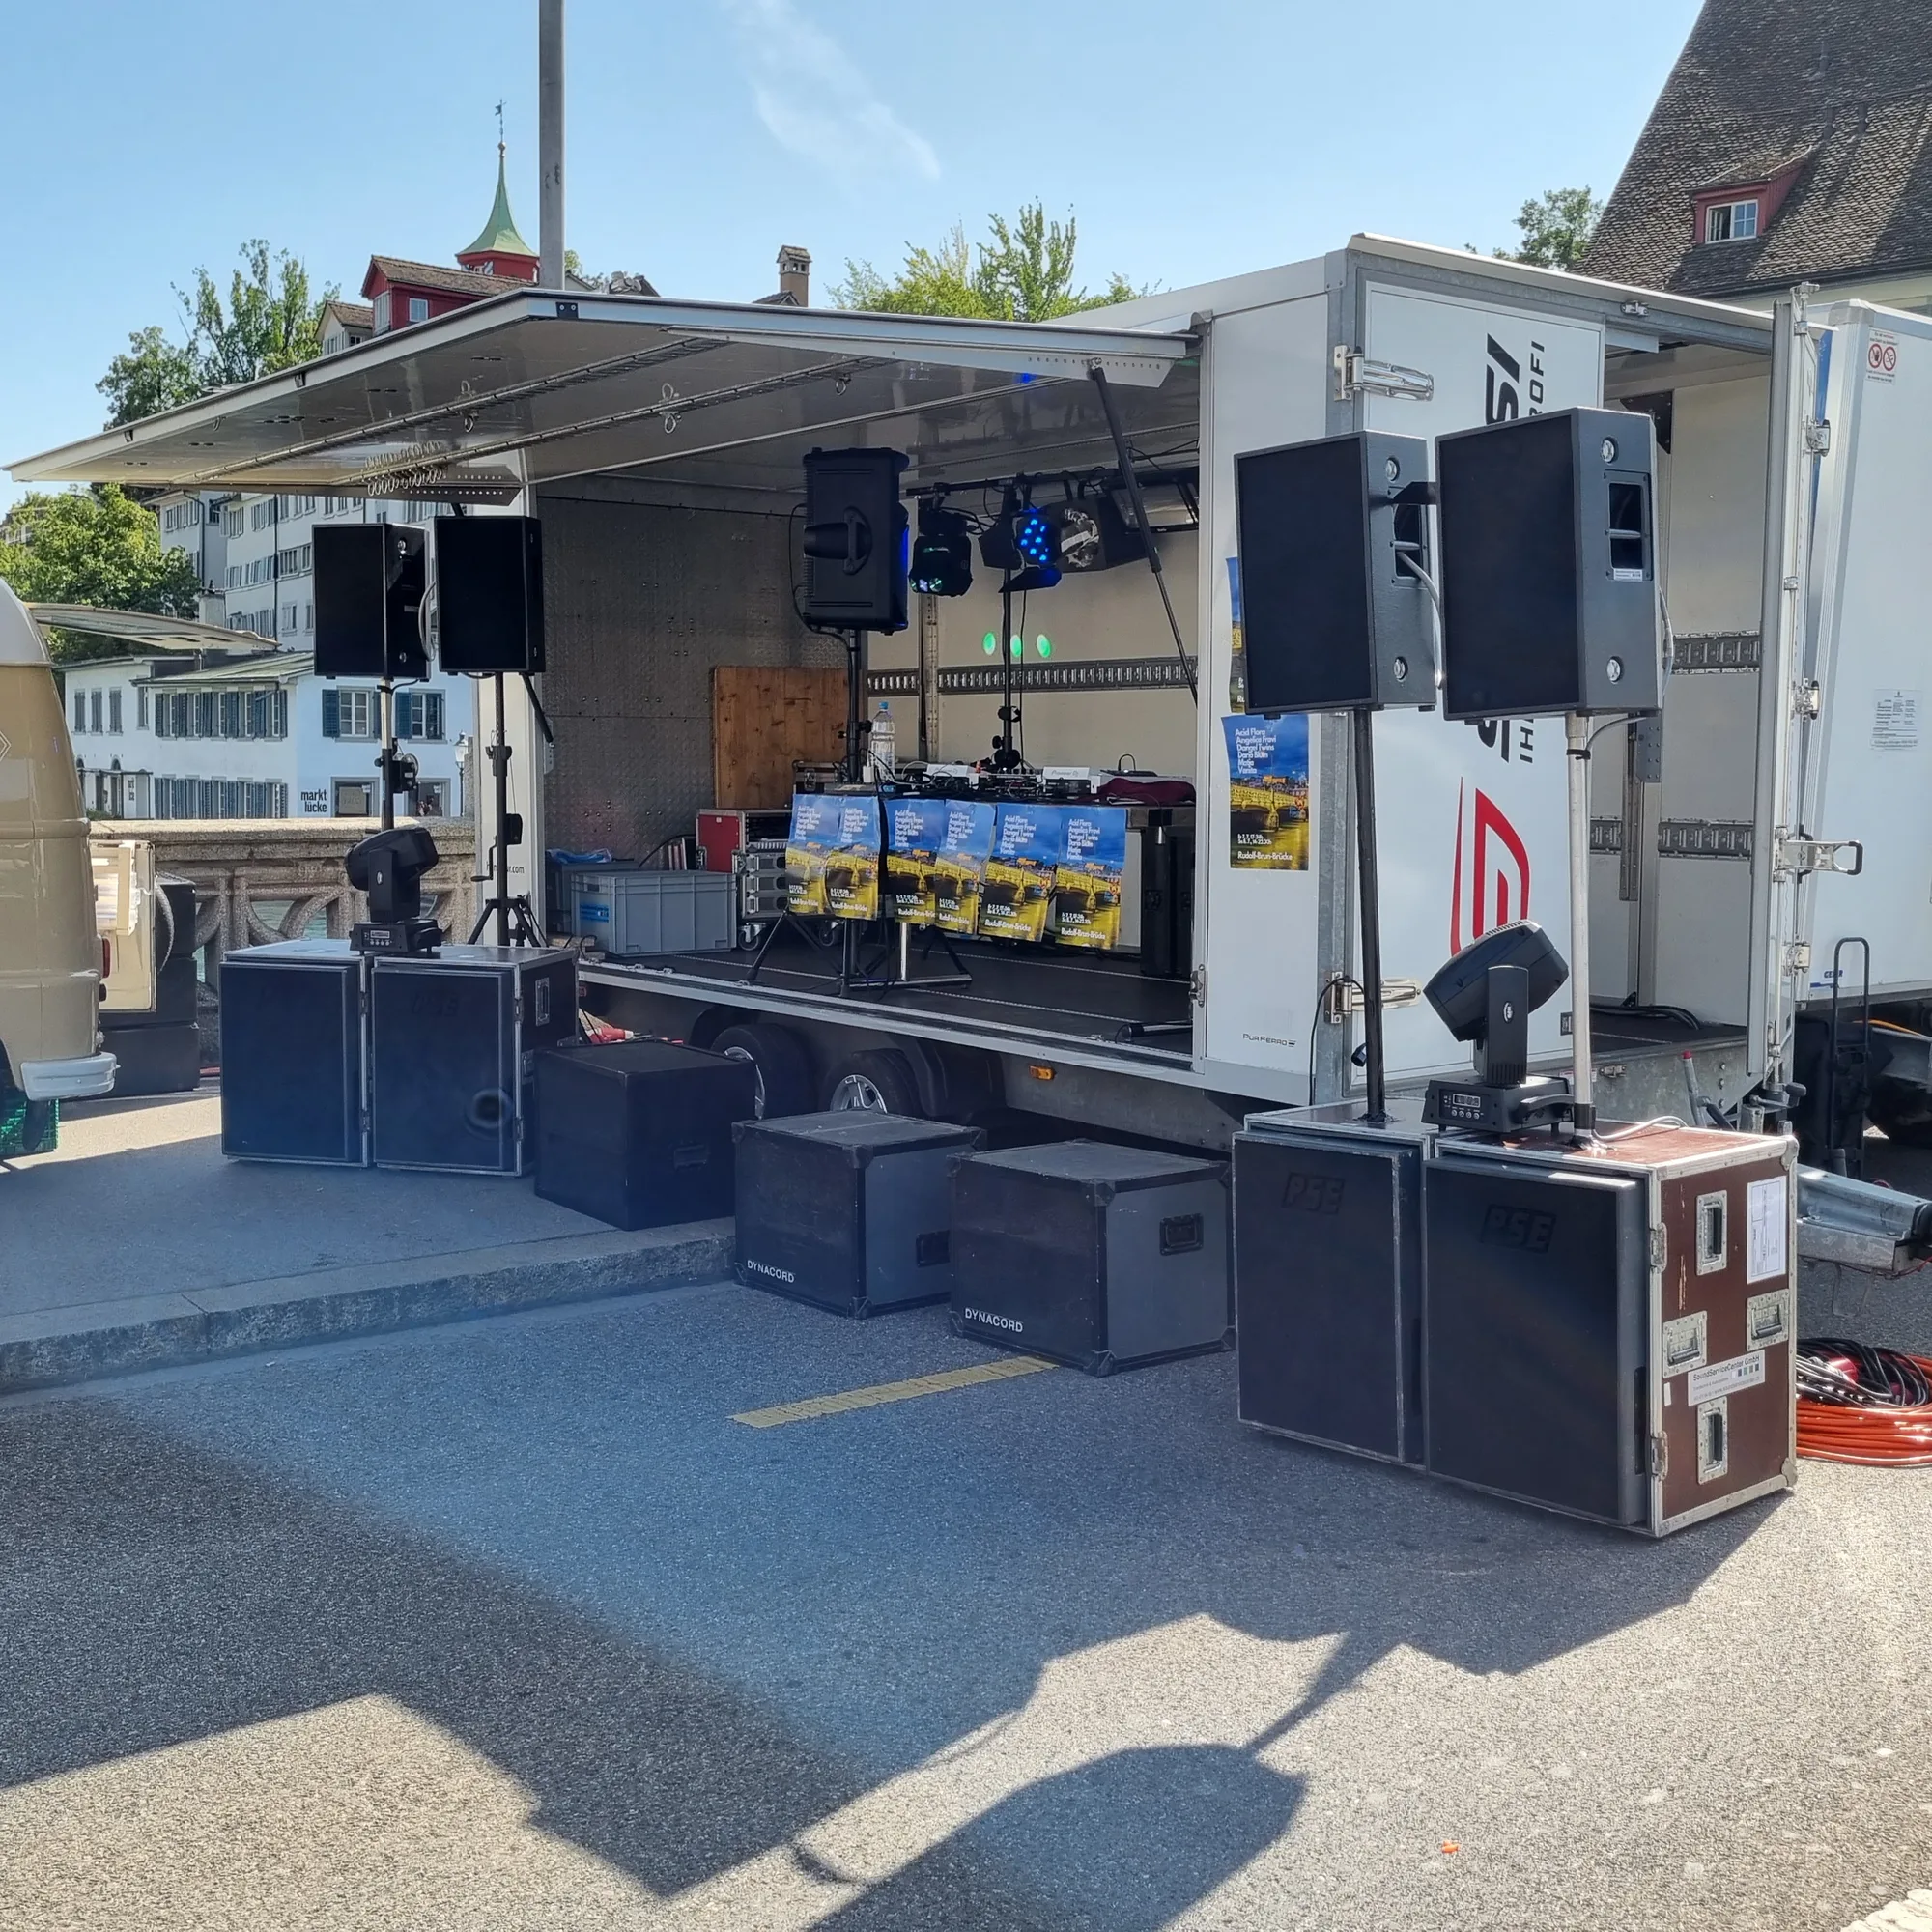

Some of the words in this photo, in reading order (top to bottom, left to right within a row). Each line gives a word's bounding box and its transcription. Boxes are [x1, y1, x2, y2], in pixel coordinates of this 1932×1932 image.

[1529, 340, 1545, 417] OFI
[1235, 728, 1250, 737] Acid
[1236, 736, 1262, 746] Angelica
[1519, 720, 1534, 764] IH
[300, 788, 327, 801] markt
[304, 801, 327, 813] lücke
[1237, 850, 1293, 861] Rudolf-Brun-Brücke
[1481, 1204, 1556, 1253] PSE
[747, 1259, 795, 1283] DYNACORD
[964, 1307, 1024, 1333] DYNACORD
[1692, 1360, 1744, 1381] SoundServiceCenter
